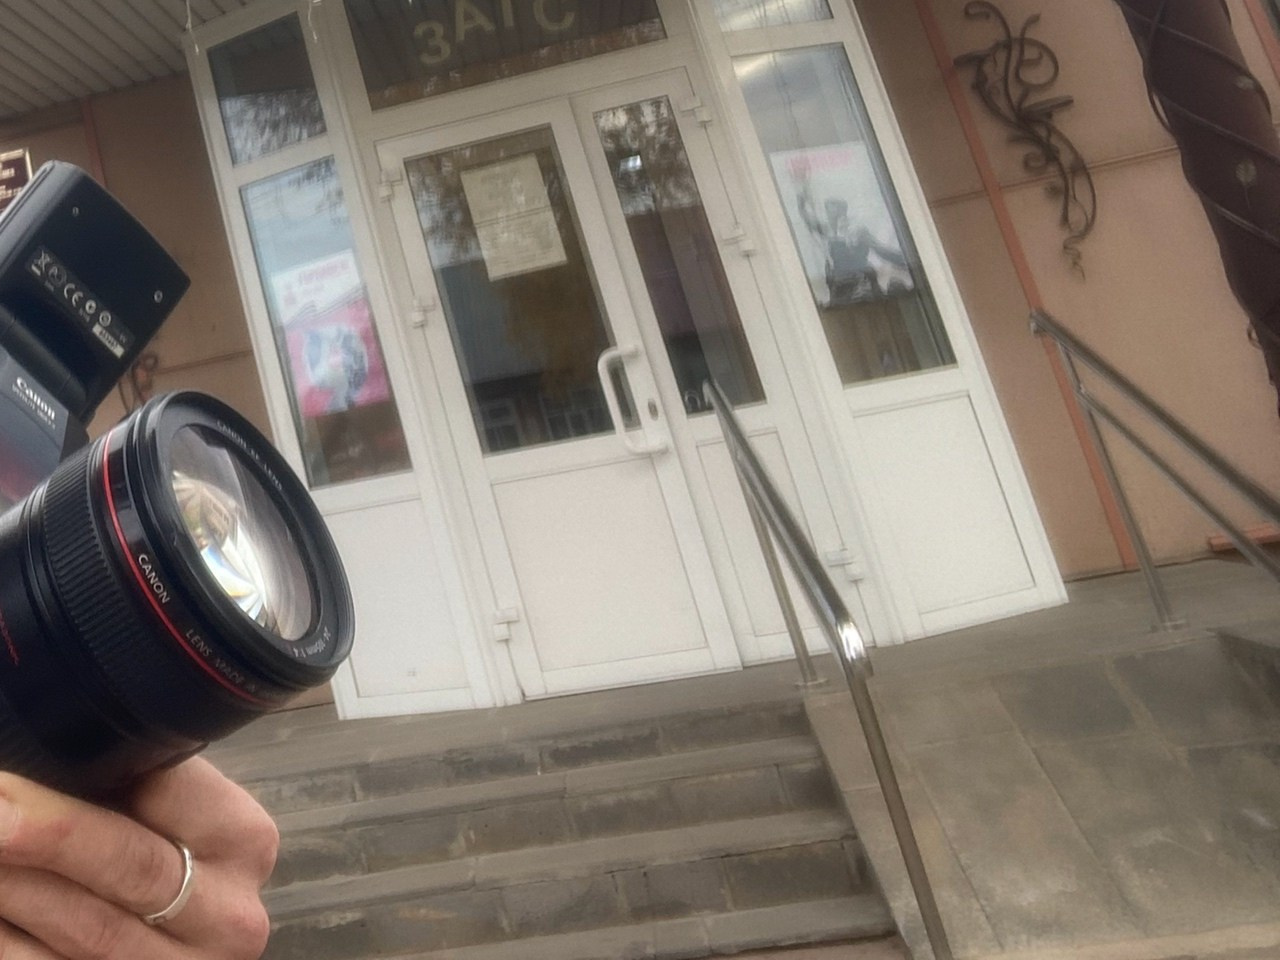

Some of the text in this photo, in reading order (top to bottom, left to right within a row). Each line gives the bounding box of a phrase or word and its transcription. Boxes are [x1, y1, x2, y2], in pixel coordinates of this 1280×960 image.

[16, 376, 55, 421] Canon
[138, 554, 170, 604] CANON
[185, 628, 213, 657] LENS
